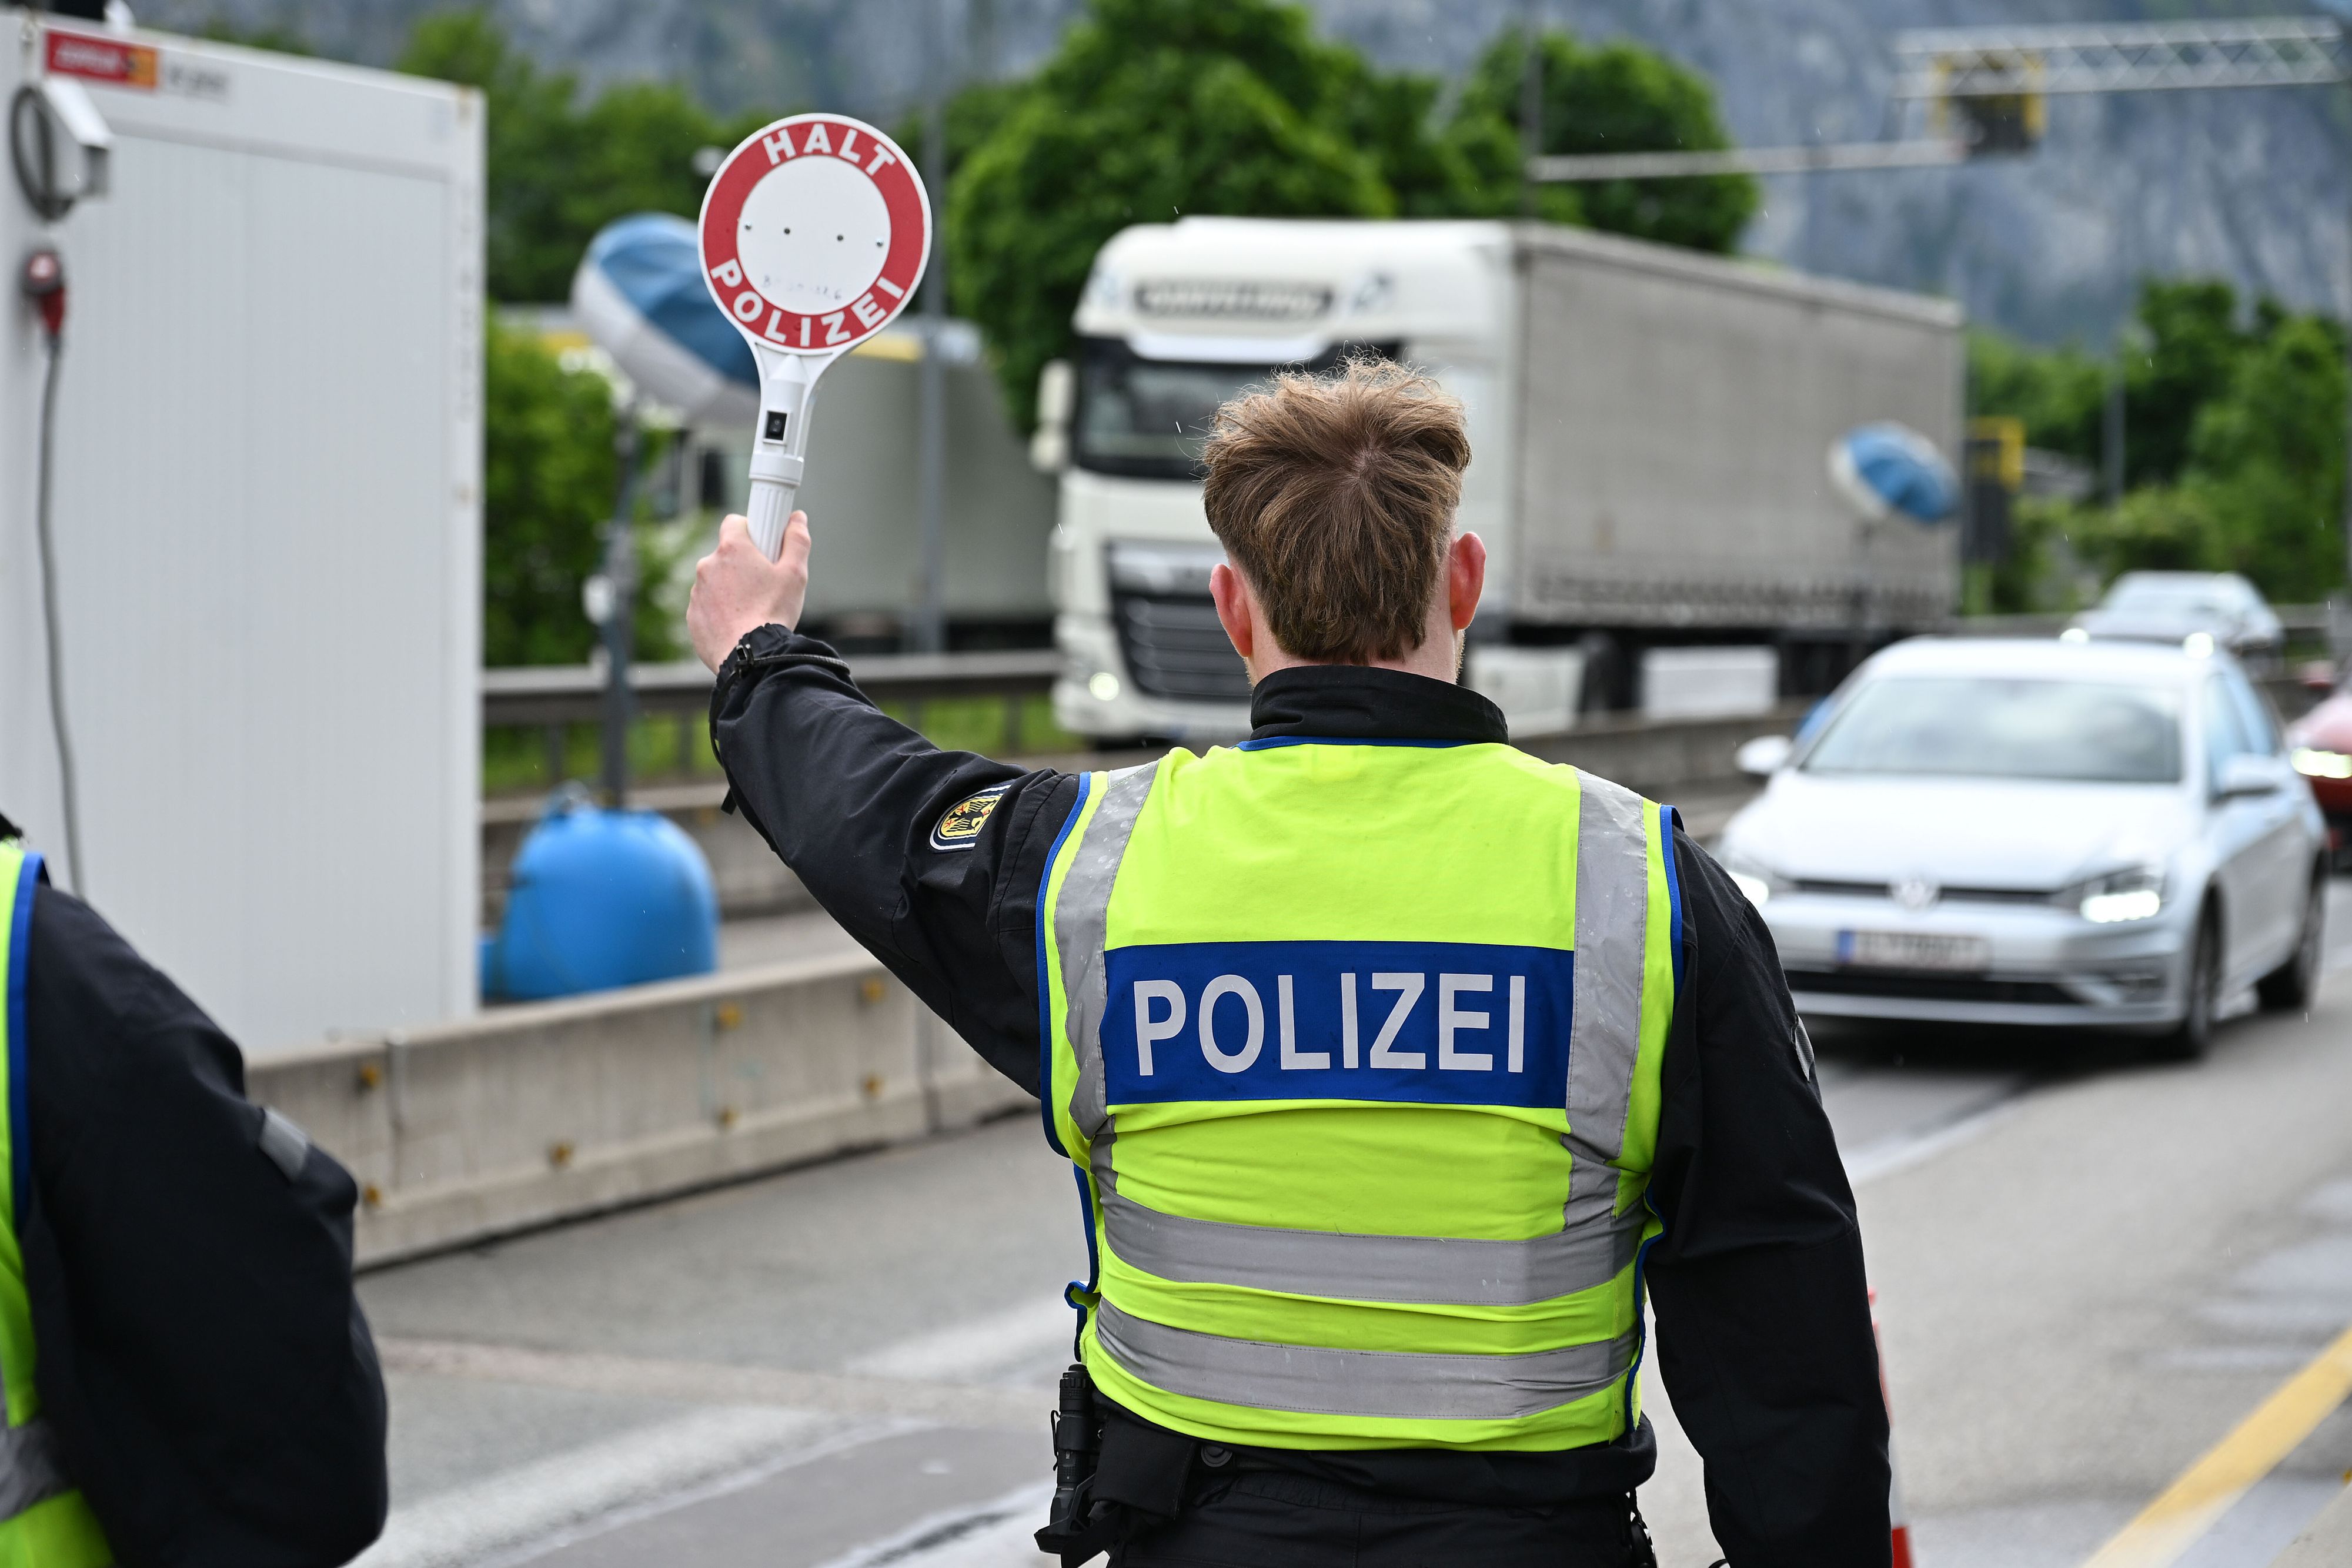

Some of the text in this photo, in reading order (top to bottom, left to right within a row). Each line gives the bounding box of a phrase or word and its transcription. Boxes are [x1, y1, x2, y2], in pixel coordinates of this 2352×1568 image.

[762, 123, 896, 176] HALT
[710, 259, 904, 347] POLIZEI
[1133, 972, 1525, 1076] POLIZEI
